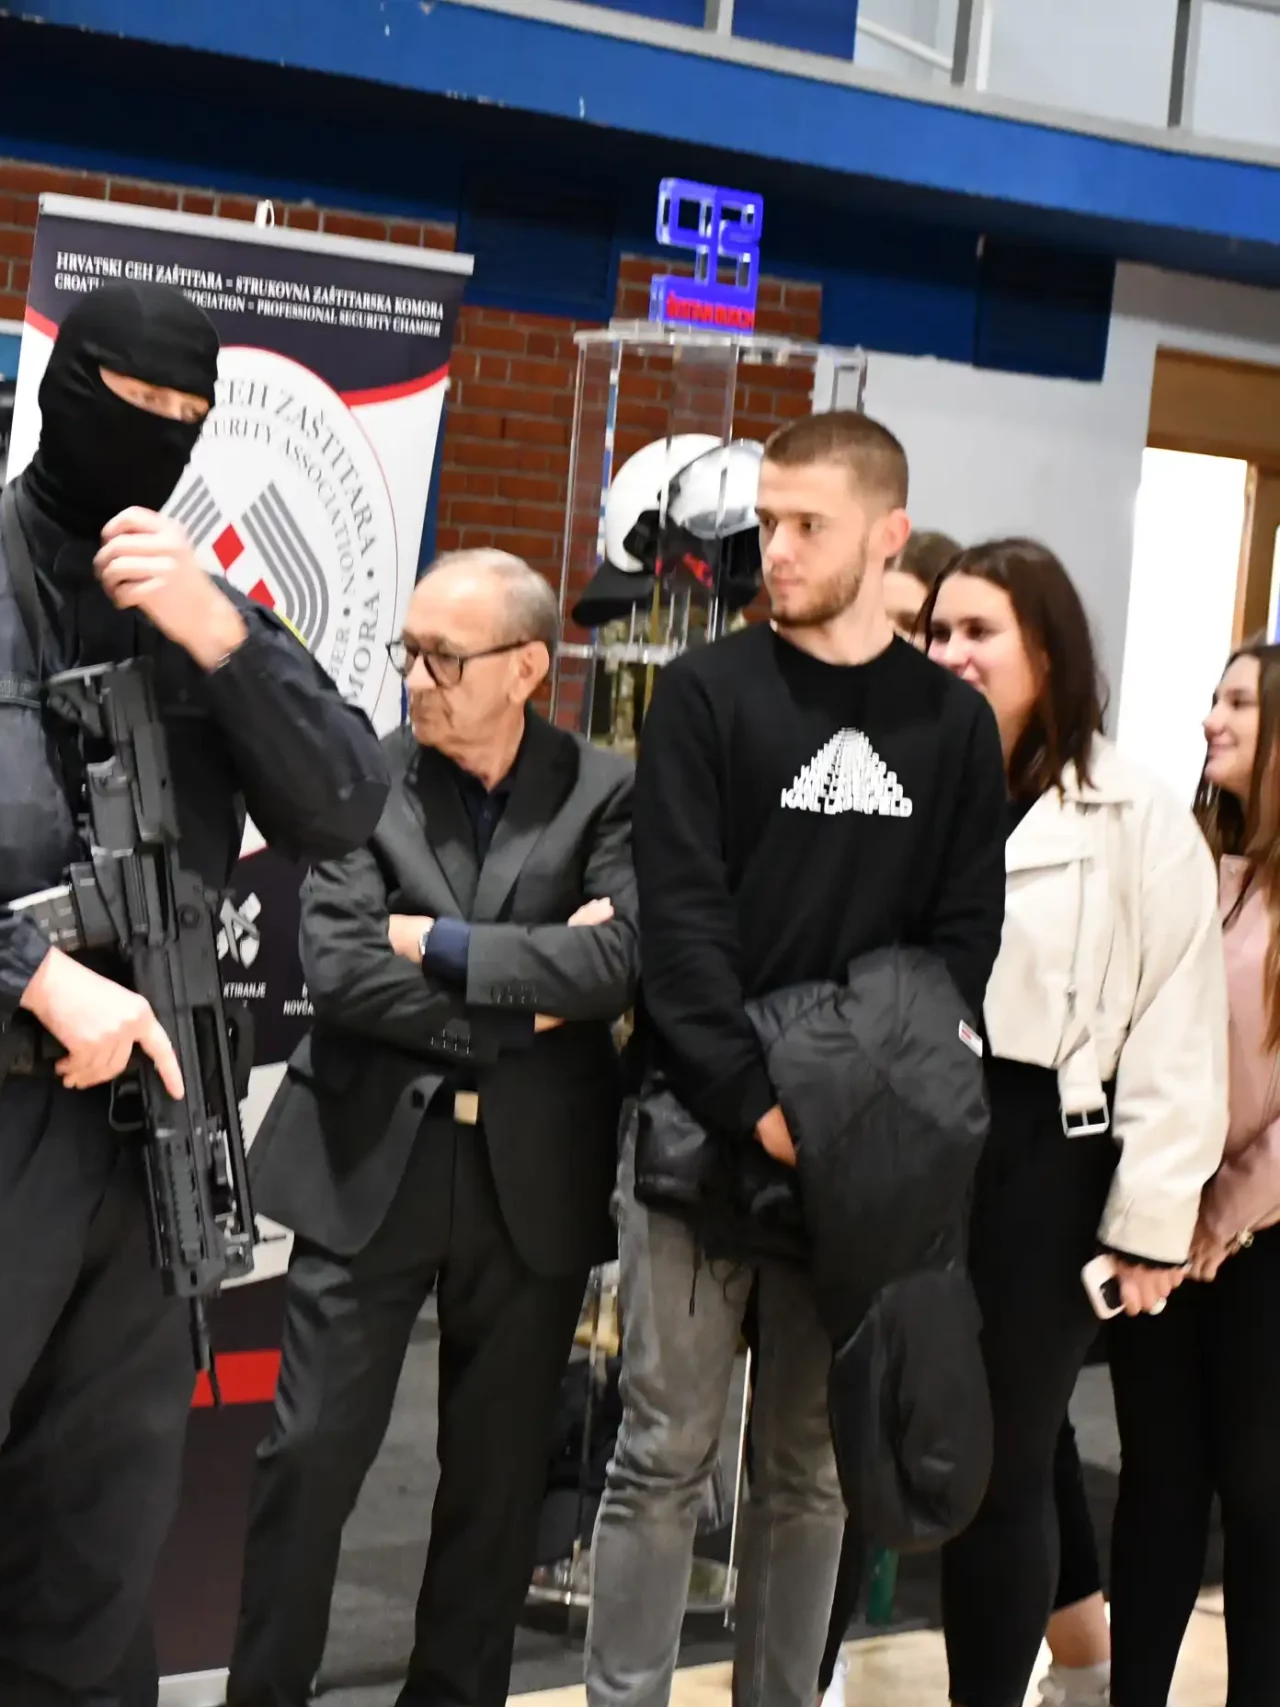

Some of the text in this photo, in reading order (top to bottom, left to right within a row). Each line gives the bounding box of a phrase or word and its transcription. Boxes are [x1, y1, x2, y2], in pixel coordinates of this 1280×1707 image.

[56, 251, 444, 320] HRVATSKI CEH ZAŠTITARA STRUKOVNA ZAŠTITARSKA KOMORA
[257, 299, 338, 325] PROFESSIONAL
[339, 309, 392, 331] SECURITY
[392, 316, 441, 338] CHAMBER
